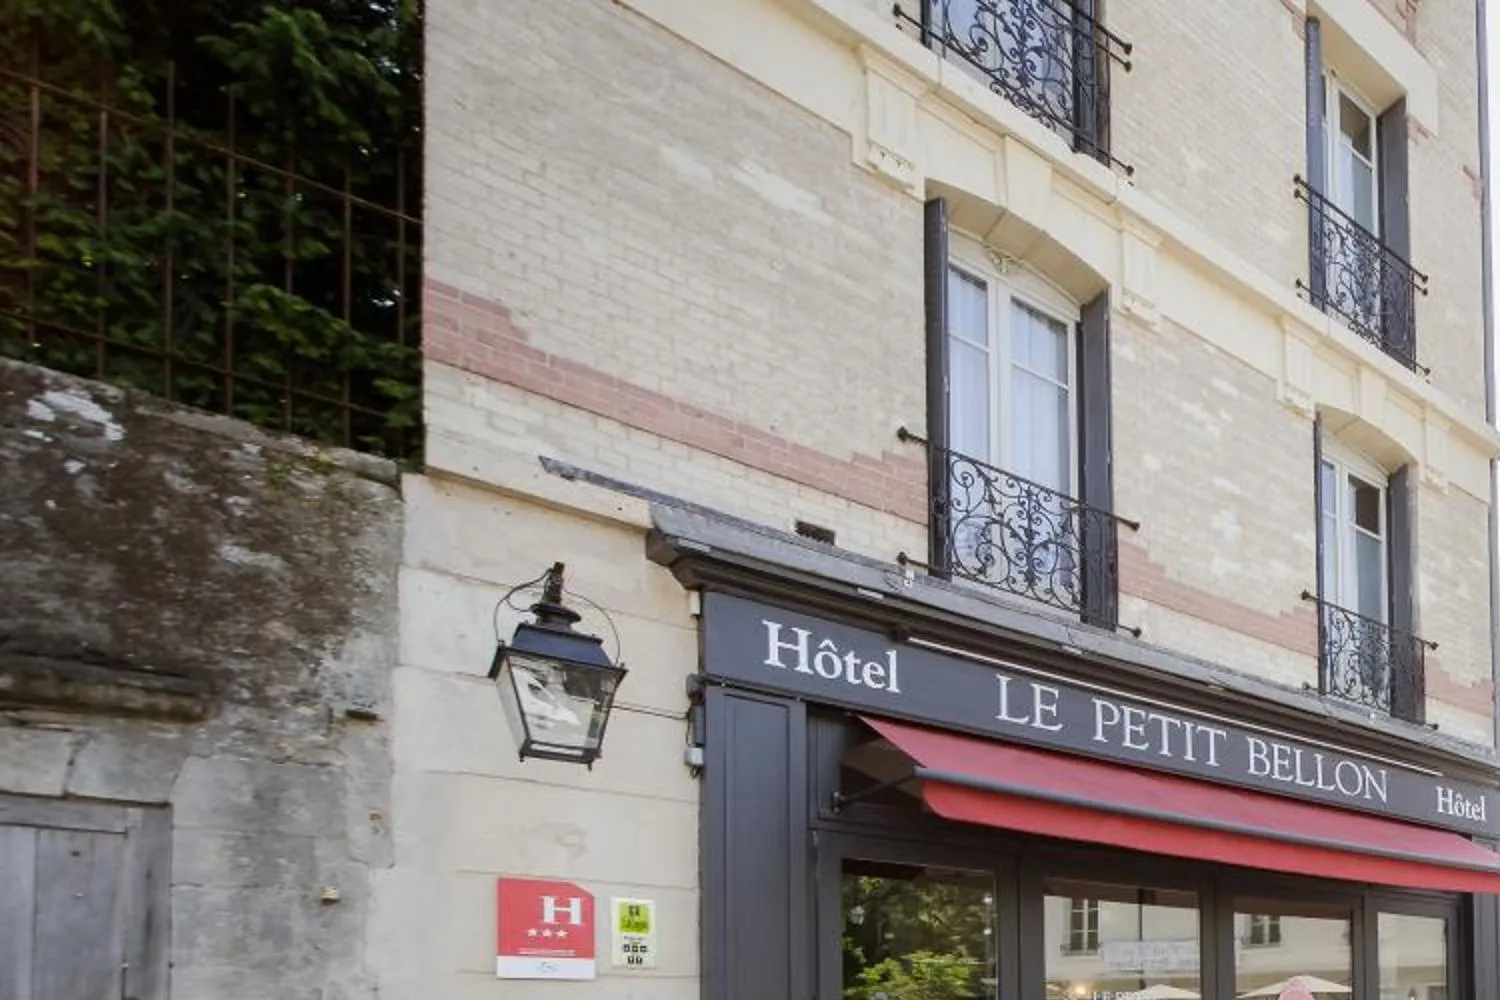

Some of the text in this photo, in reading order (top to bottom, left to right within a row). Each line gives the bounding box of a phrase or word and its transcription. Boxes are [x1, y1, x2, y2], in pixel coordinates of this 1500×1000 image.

[761, 619, 901, 693] Hôtel
[995, 672, 1388, 804] LE PETIT BELLON
[1435, 785, 1487, 822] Hôtel
[539, 895, 585, 926] H
